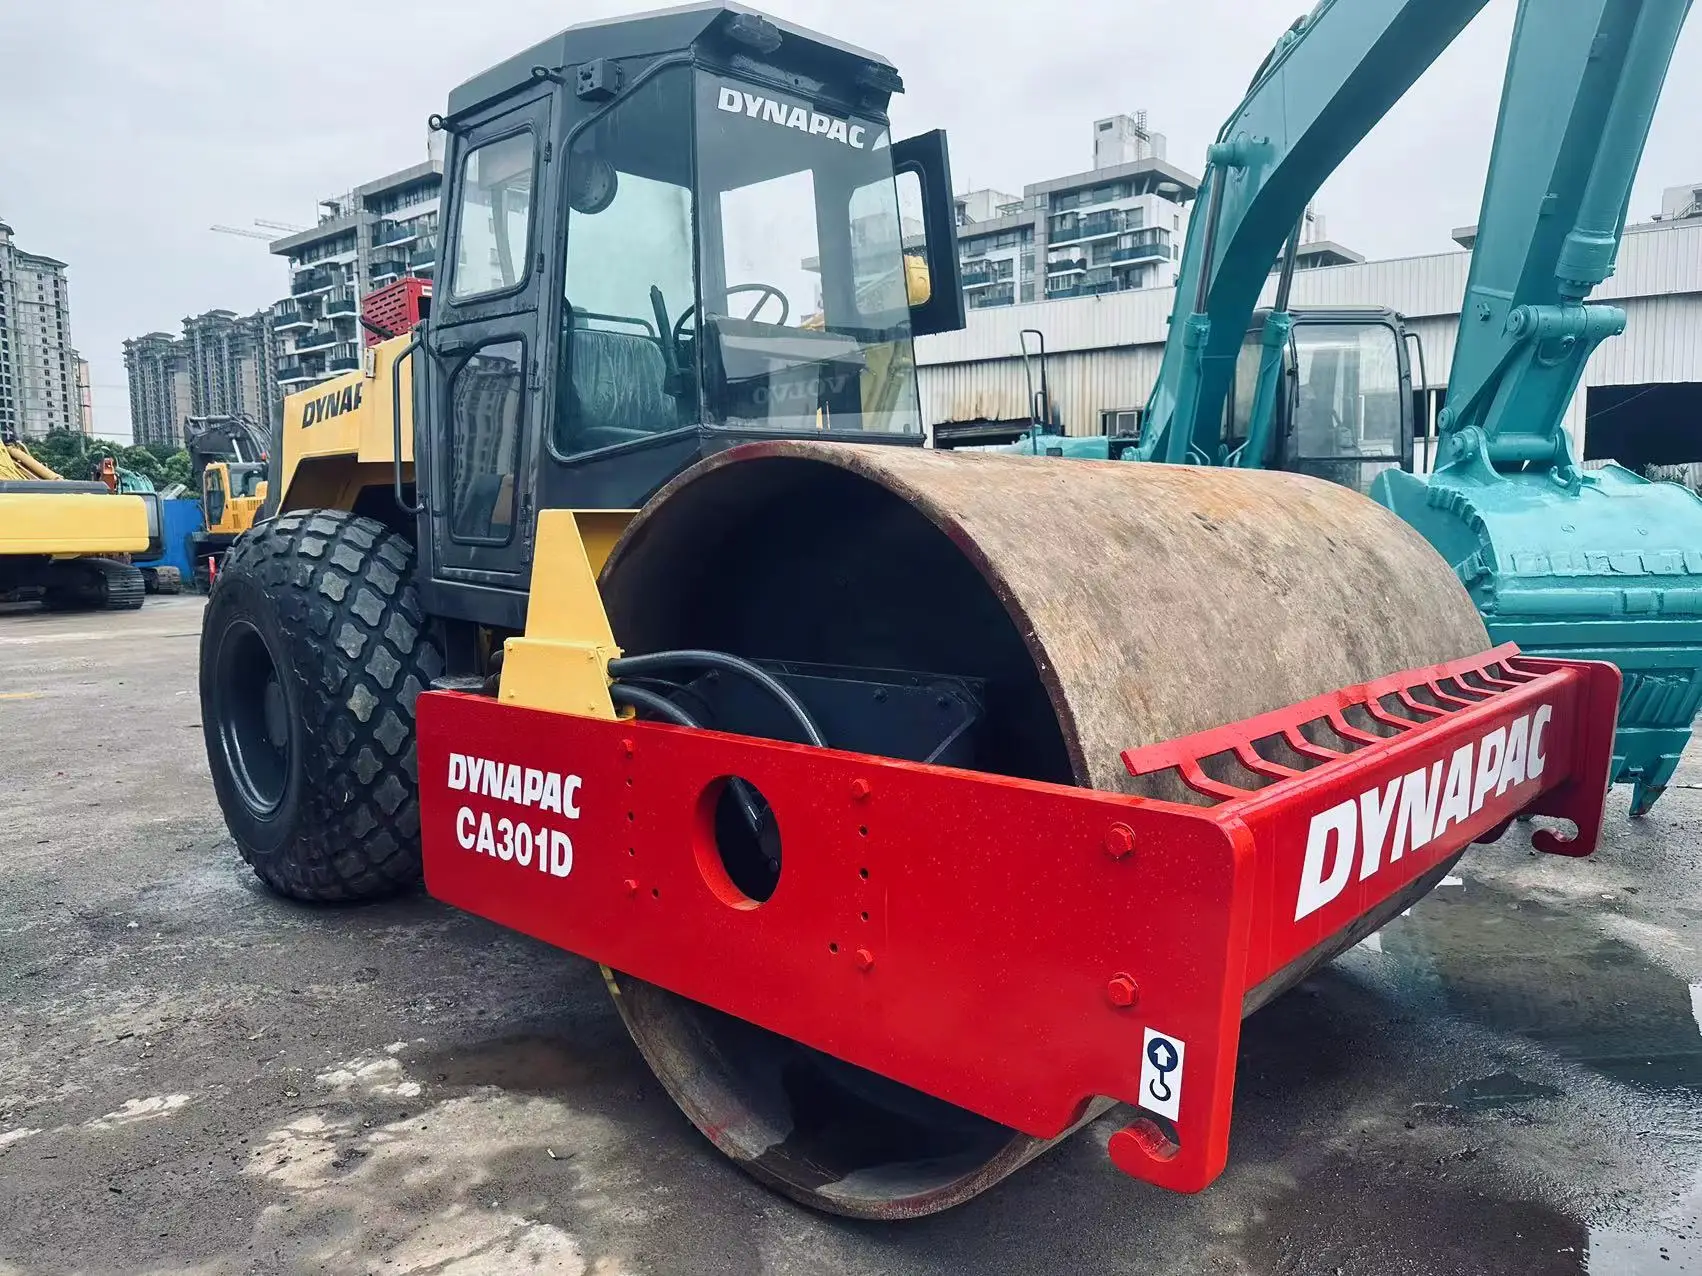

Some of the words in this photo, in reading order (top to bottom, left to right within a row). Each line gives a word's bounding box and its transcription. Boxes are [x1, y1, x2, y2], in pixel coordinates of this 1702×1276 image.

[718, 86, 866, 149] DYNAPAC
[447, 752, 582, 819] DYNAPAC
[1294, 703, 1552, 923] DYNAPAC
[456, 806, 573, 878] CA301D
